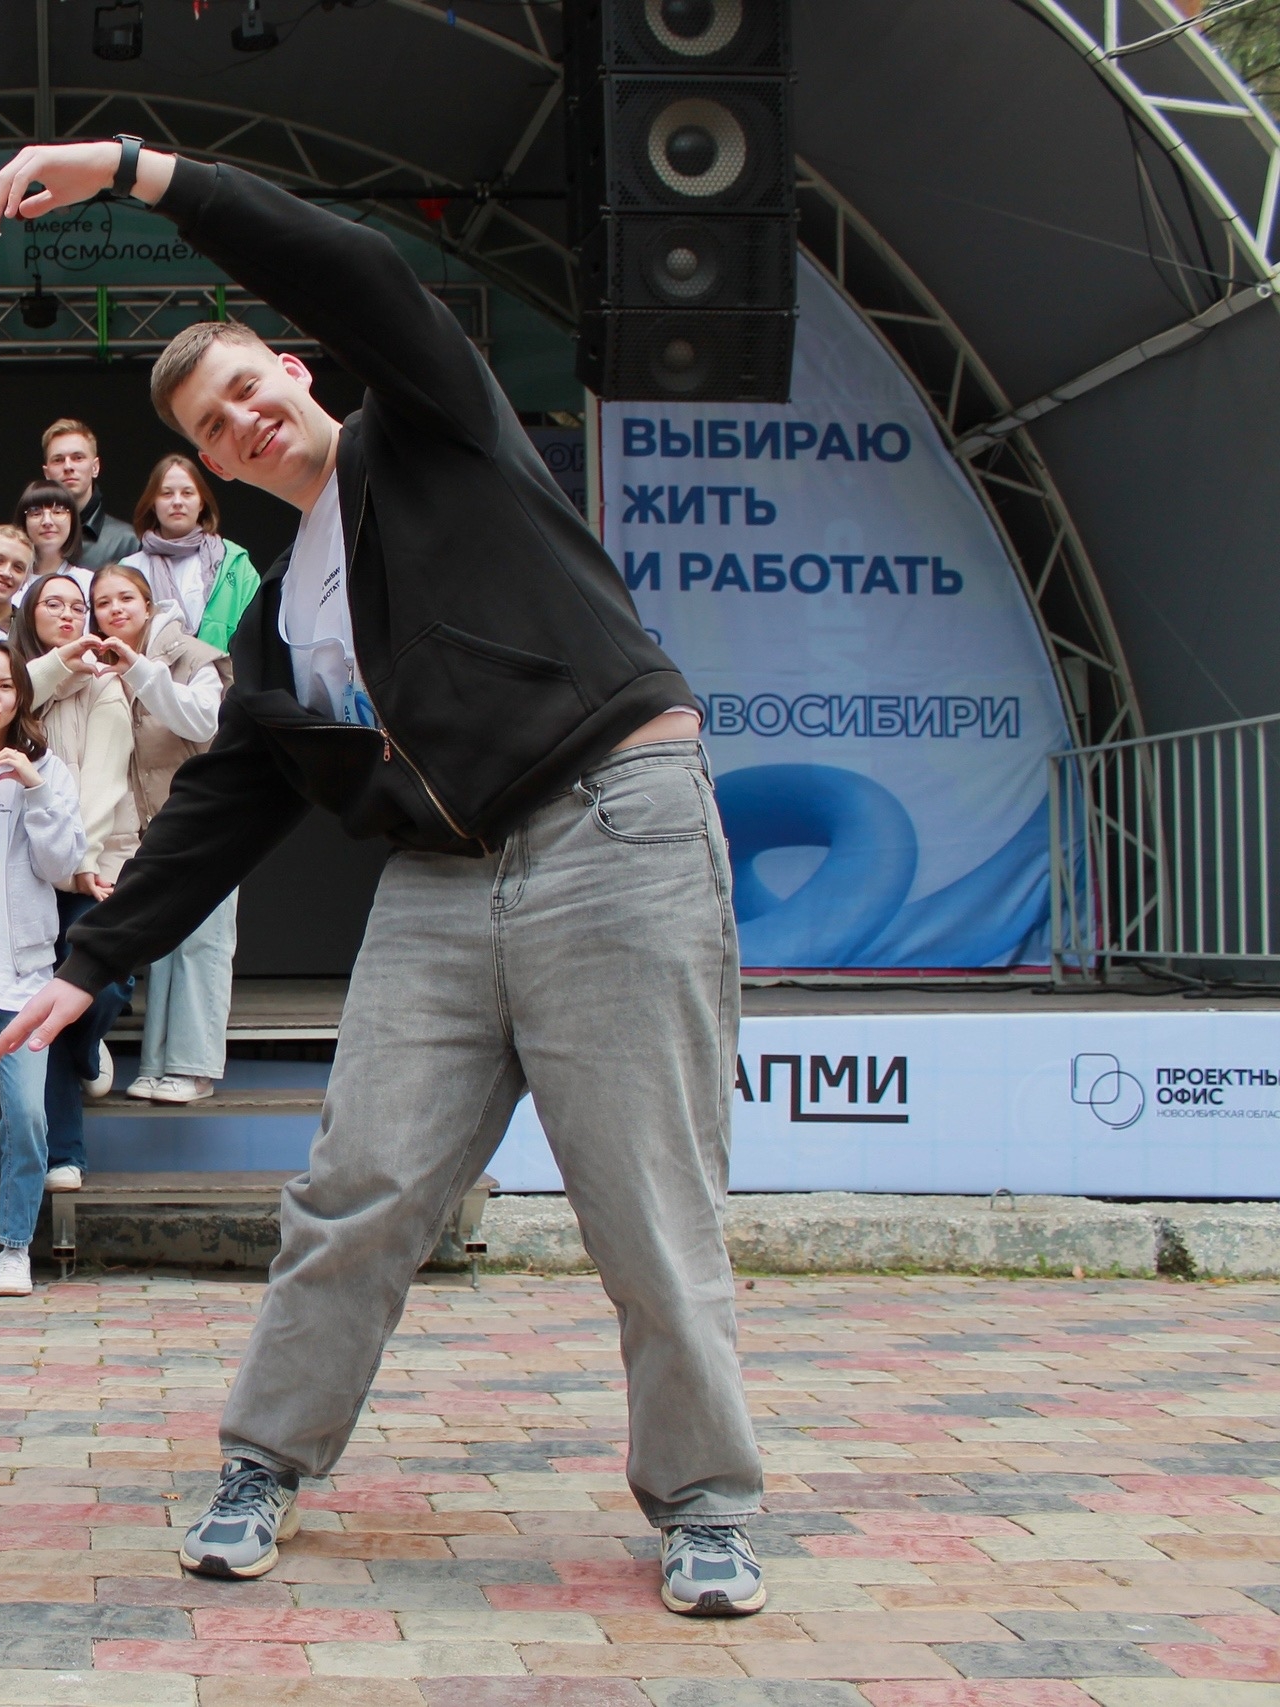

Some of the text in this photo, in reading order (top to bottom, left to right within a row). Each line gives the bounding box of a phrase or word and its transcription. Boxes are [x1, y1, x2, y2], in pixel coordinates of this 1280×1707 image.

[24, 219, 93, 233] вместе
[622, 418, 912, 463] ВЫБИРАЮ
[622, 485, 777, 526] ЖИТЬ
[624, 552, 964, 596] И РАБОТАТЬ
[1156, 1087, 1224, 1105] ОФИС
[1156, 1109, 1243, 1118] НОВОСИБИРСКАЯ
